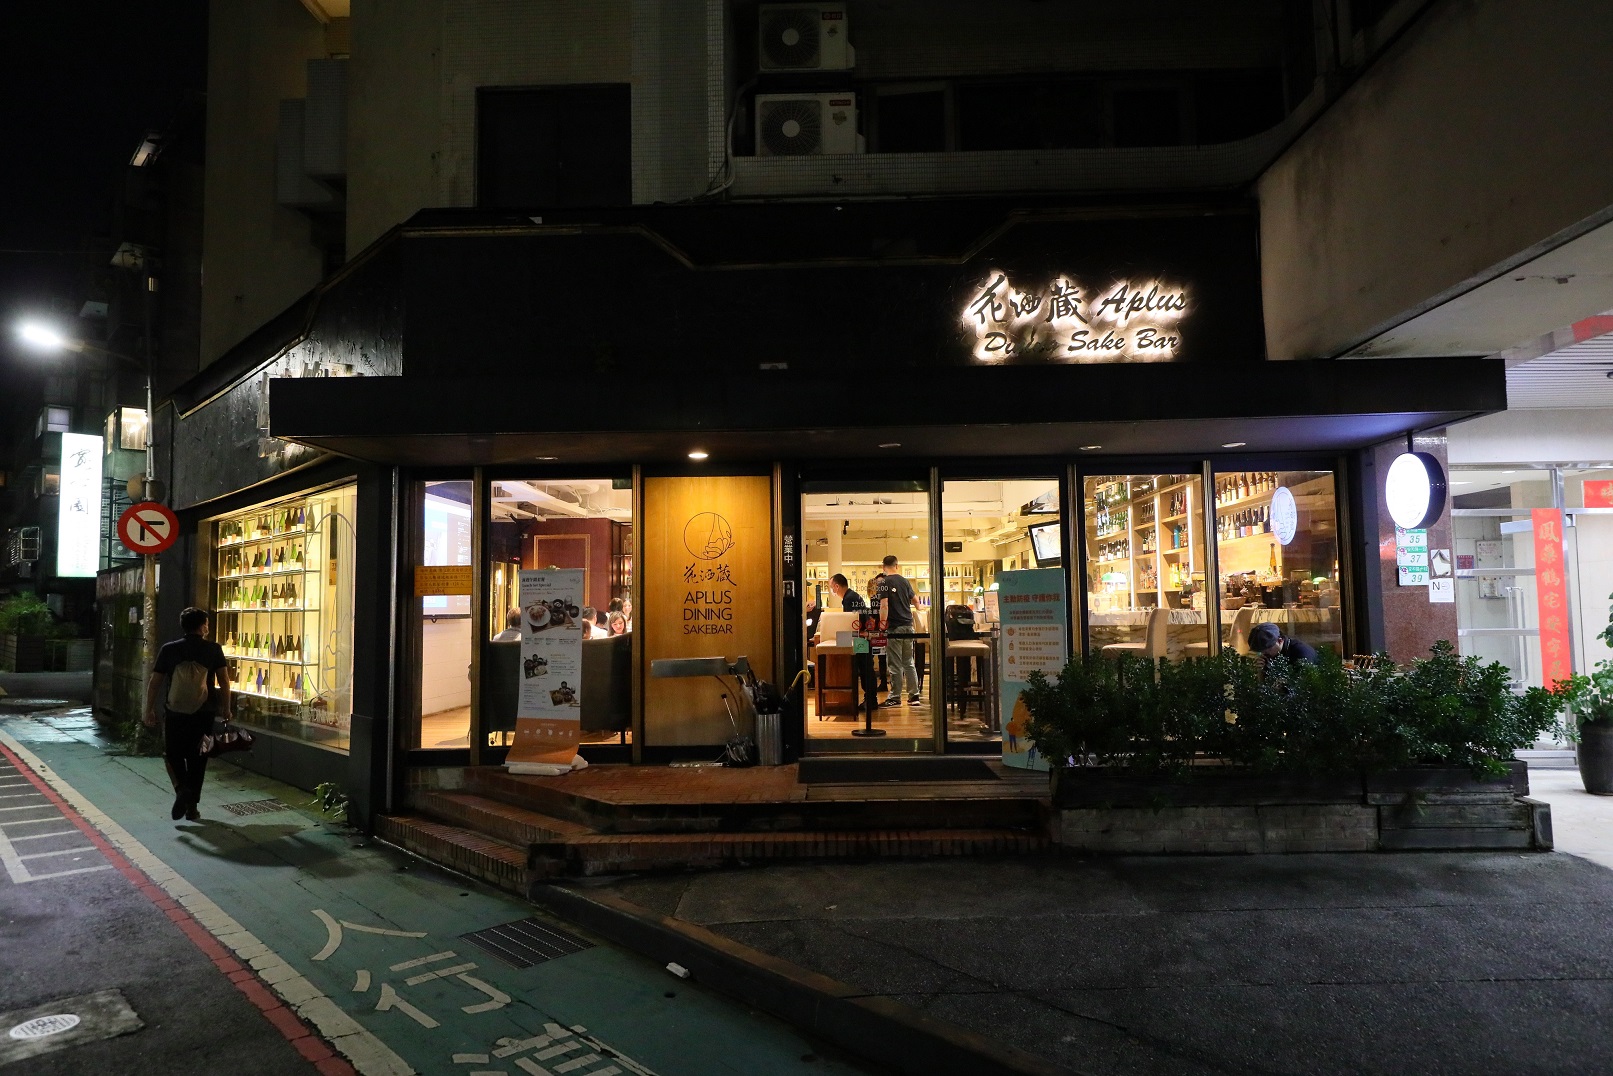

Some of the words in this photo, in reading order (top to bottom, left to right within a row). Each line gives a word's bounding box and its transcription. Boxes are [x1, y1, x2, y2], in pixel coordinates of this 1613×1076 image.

[1096, 284, 1189, 320] Aplus
[1067, 330, 1127, 352] Sake
[1136, 327, 1179, 350] Bar
[1409, 535, 1421, 544] 35
[783, 534, 794, 564] 營業中
[1410, 554, 1422, 563] 37
[1411, 574, 1423, 583] 39
[684, 590, 732, 605] APLUS
[683, 607, 733, 621] DINING
[683, 623, 733, 635] SAKEBAR
